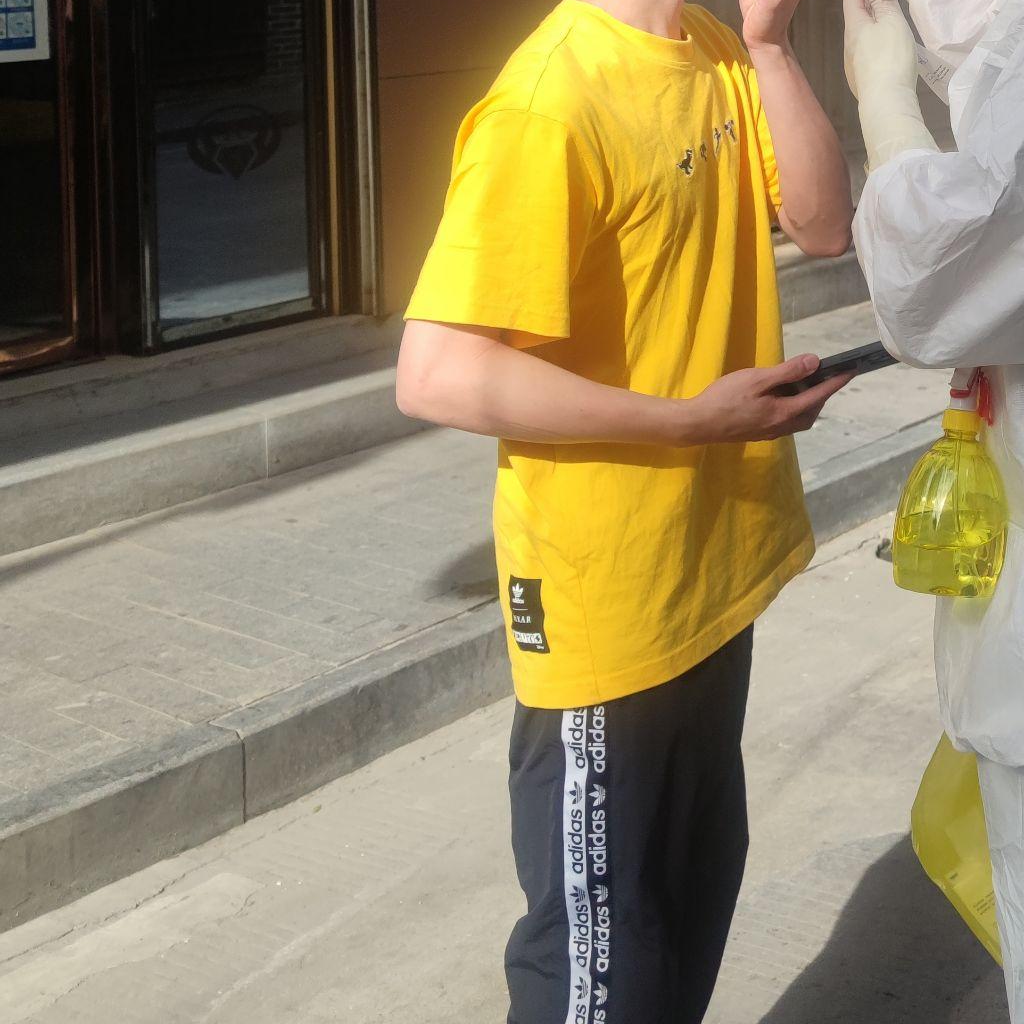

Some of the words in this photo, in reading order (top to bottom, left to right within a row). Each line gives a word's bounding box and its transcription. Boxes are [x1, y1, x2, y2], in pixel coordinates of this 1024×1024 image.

[588, 705, 606, 773] adidas
[568, 809, 584, 874] adidas
[588, 809, 606, 875] adidas
[573, 904, 590, 967] adidas
[594, 906, 611, 972] adidas
